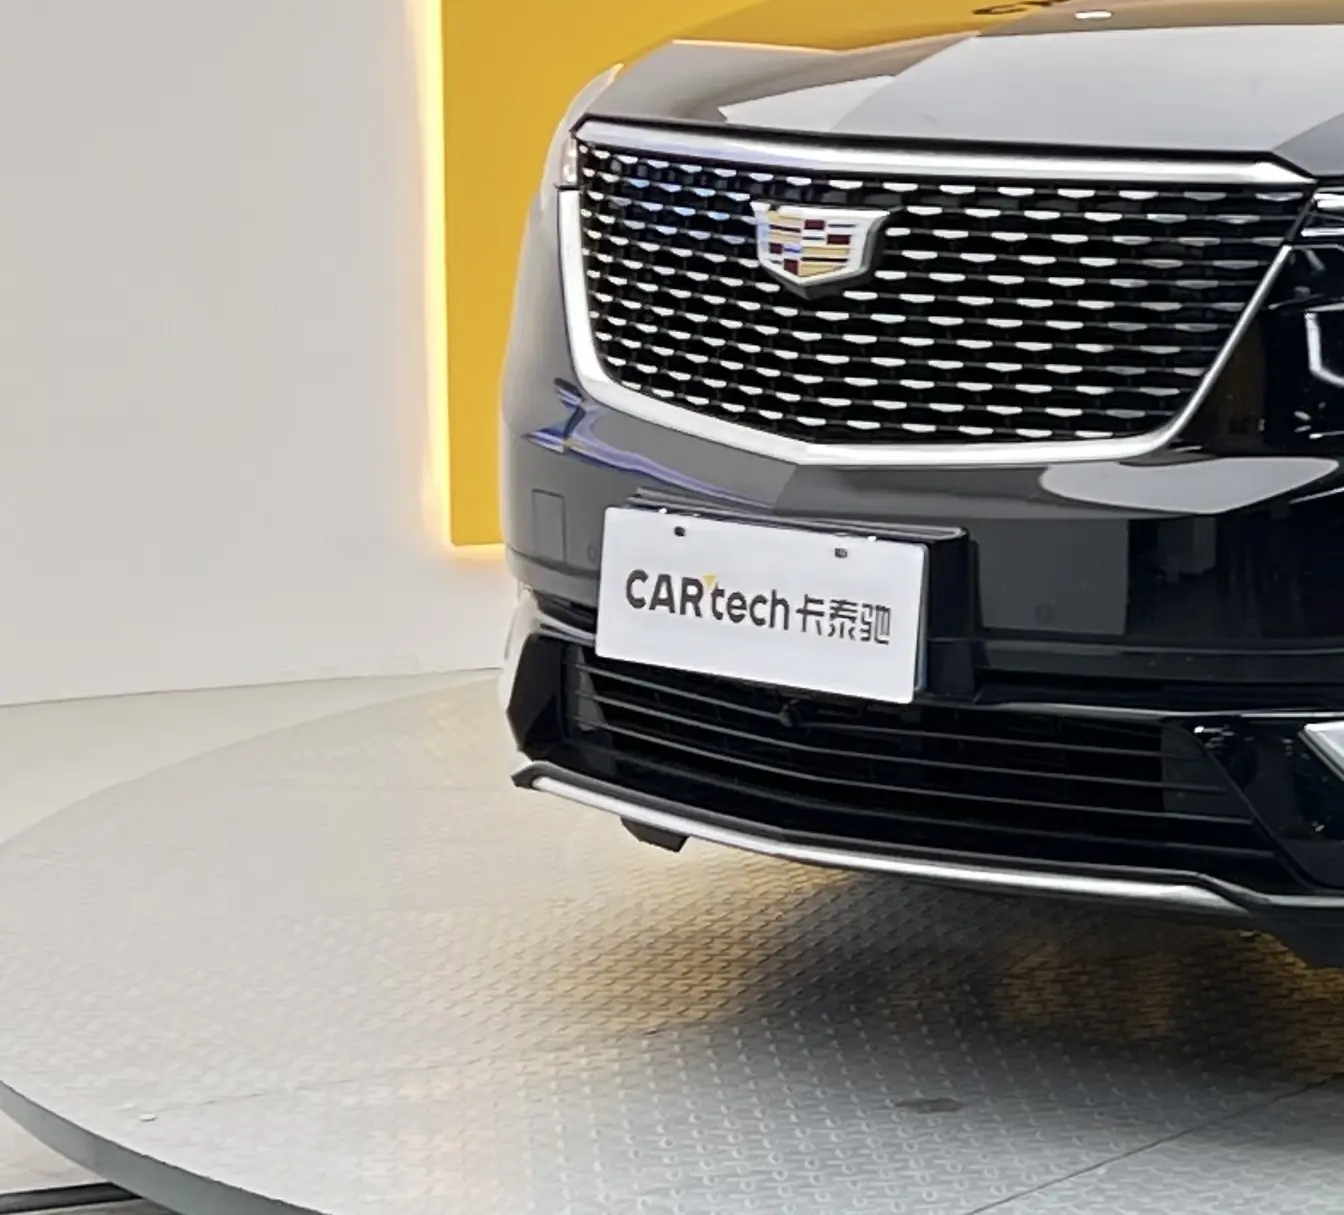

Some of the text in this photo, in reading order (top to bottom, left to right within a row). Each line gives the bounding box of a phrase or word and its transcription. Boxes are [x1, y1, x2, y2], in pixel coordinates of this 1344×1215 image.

[626, 569, 892, 646] CARtech 卡泰驰
